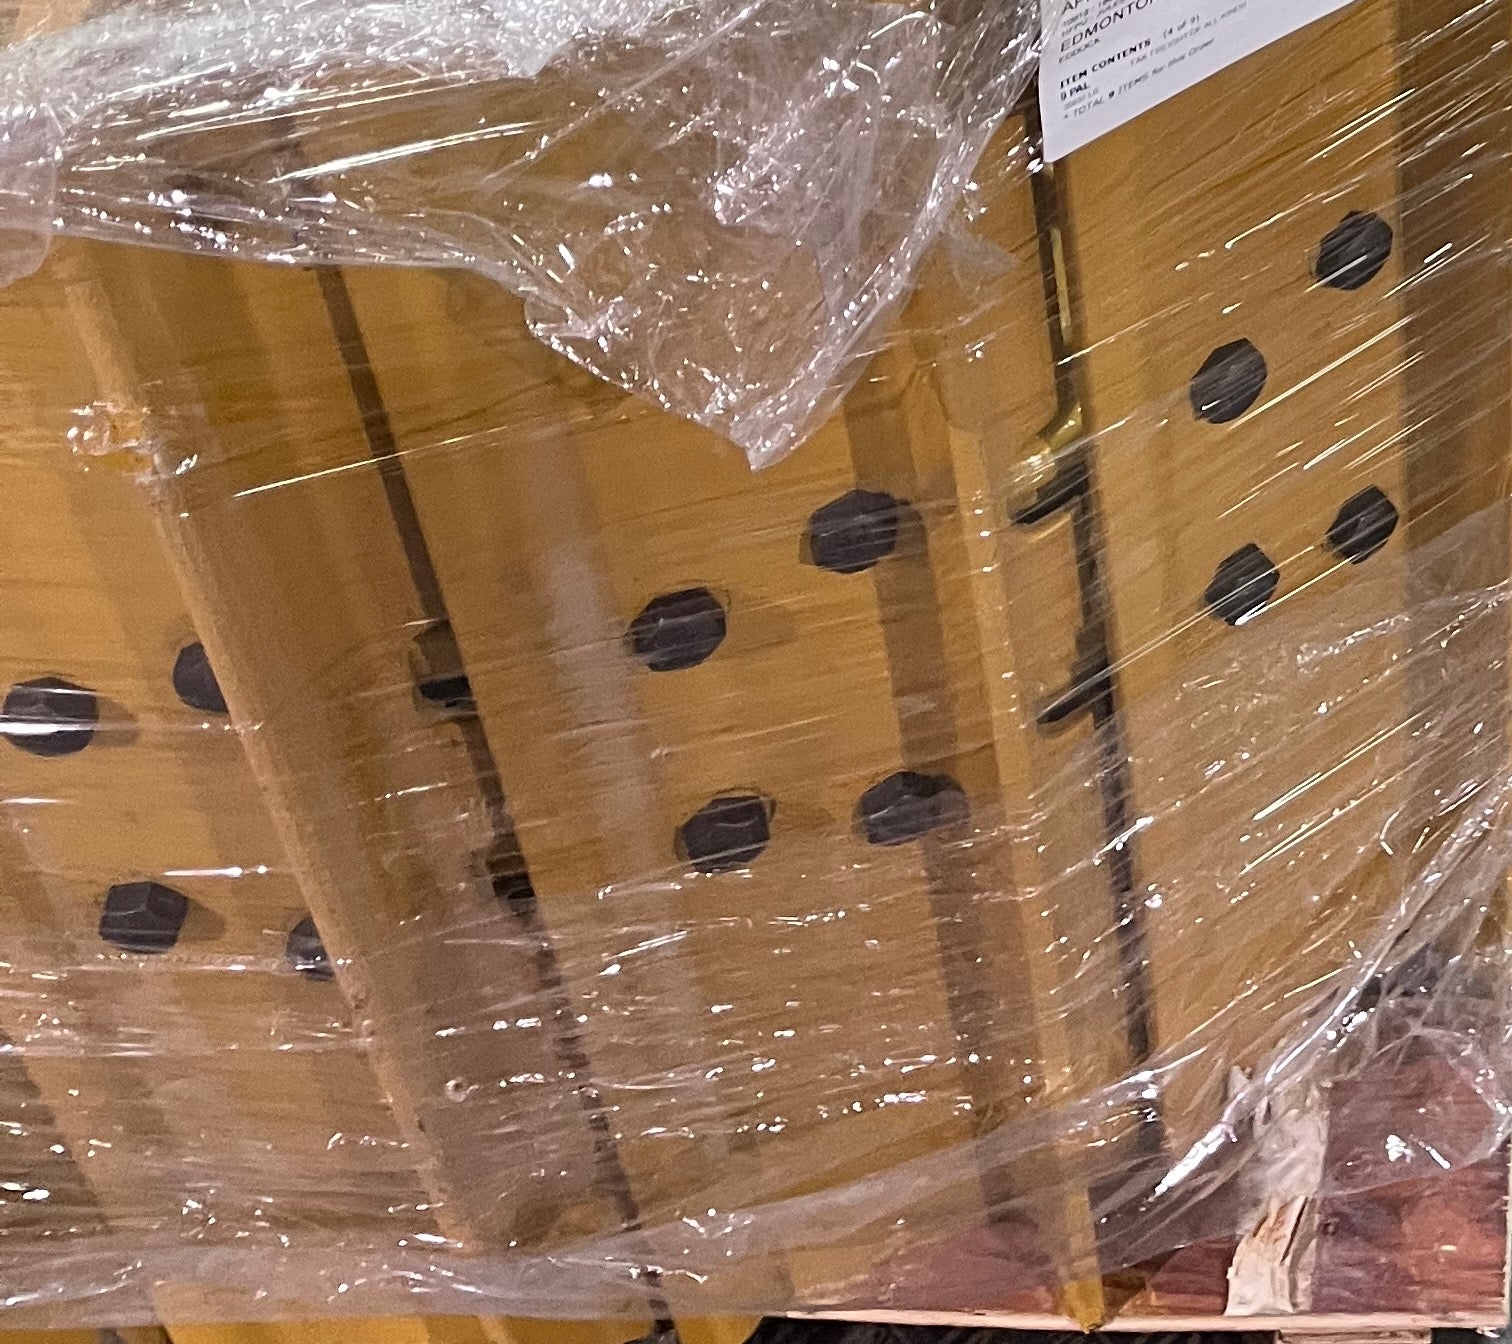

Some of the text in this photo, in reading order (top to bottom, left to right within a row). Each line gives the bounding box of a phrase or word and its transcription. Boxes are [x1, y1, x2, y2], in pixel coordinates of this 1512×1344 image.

[1059, 70, 1087, 89] ITEM
[1091, 38, 1151, 72] CONTENTS
[1069, 82, 1090, 97] PAL
[1073, 96, 1105, 118] TOTAL
[1118, 72, 1149, 96] ITEMS
